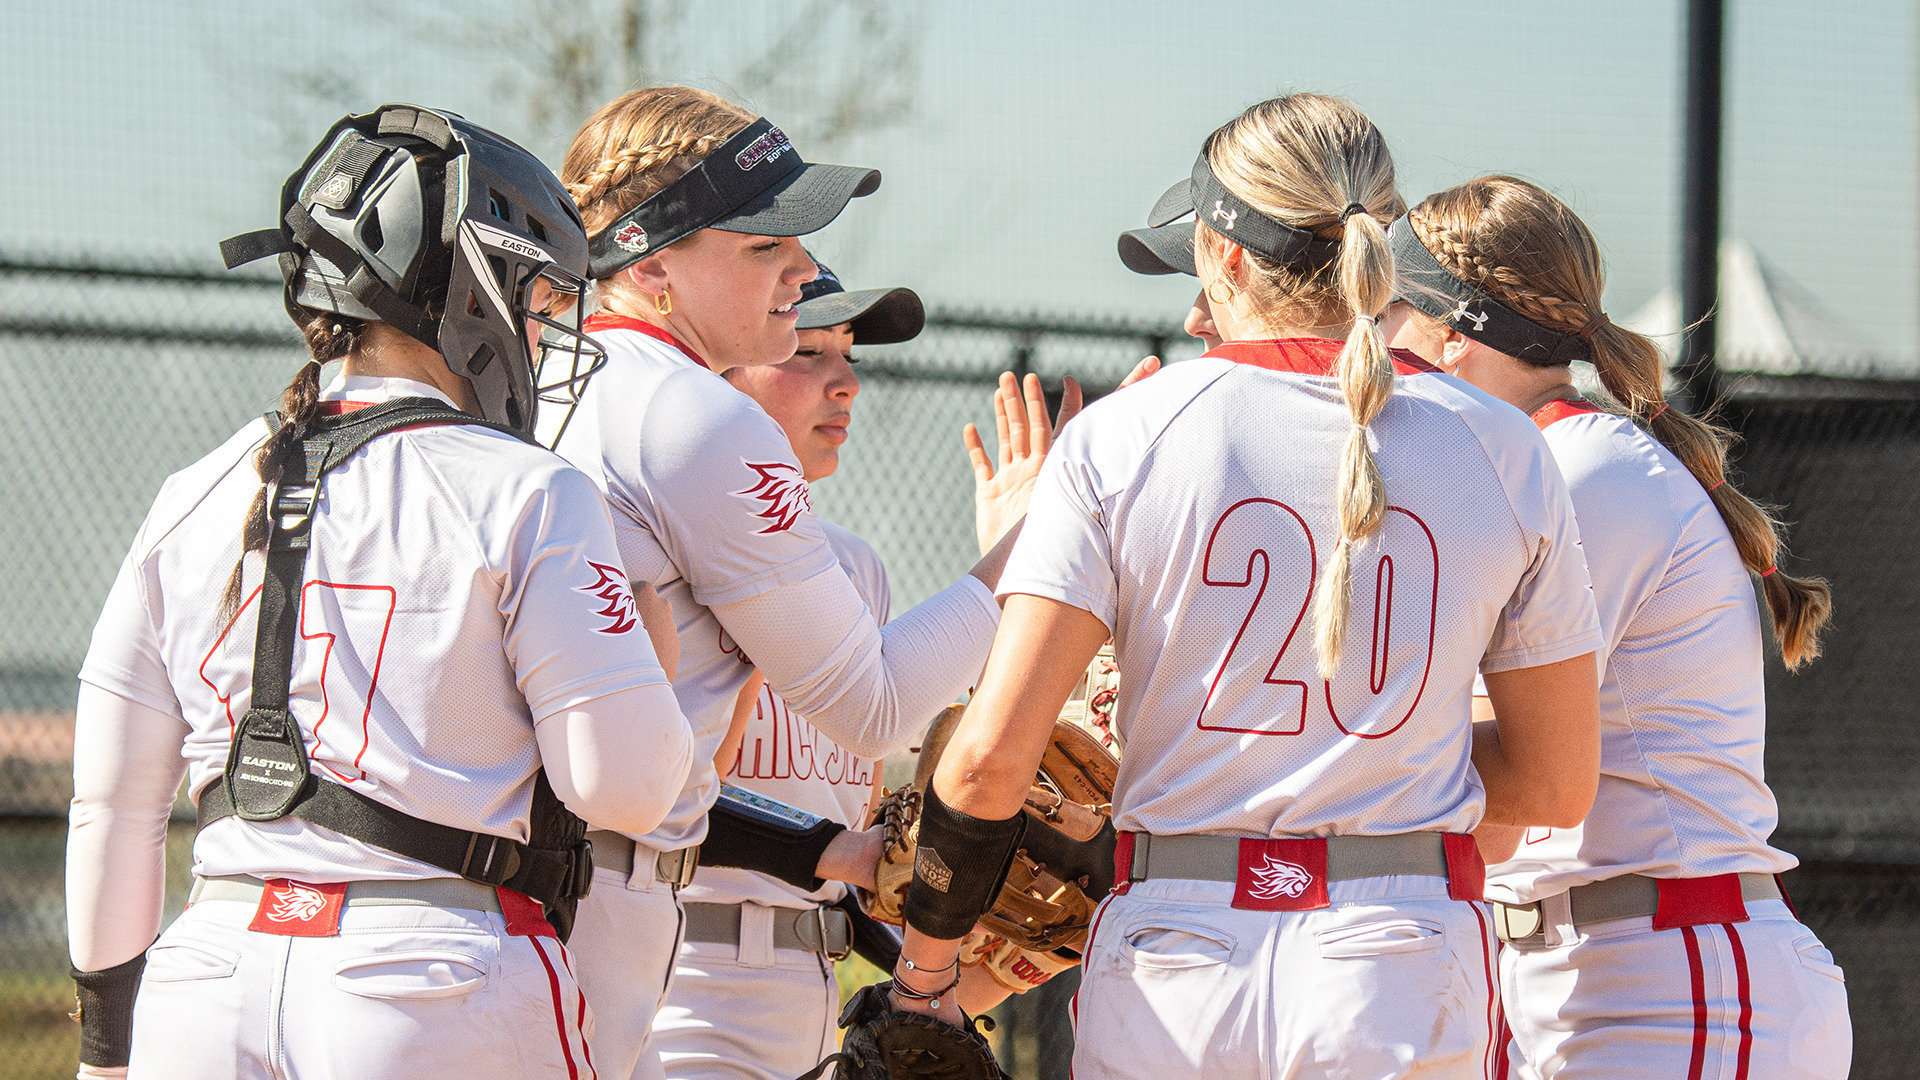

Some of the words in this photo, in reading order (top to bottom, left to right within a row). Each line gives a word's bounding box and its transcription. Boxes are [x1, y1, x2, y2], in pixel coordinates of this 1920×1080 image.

[738, 133, 778, 168] CHICO
[501, 239, 541, 258] EASTON
[1197, 497, 1439, 740] 20
[241, 755, 297, 772] EASTON
